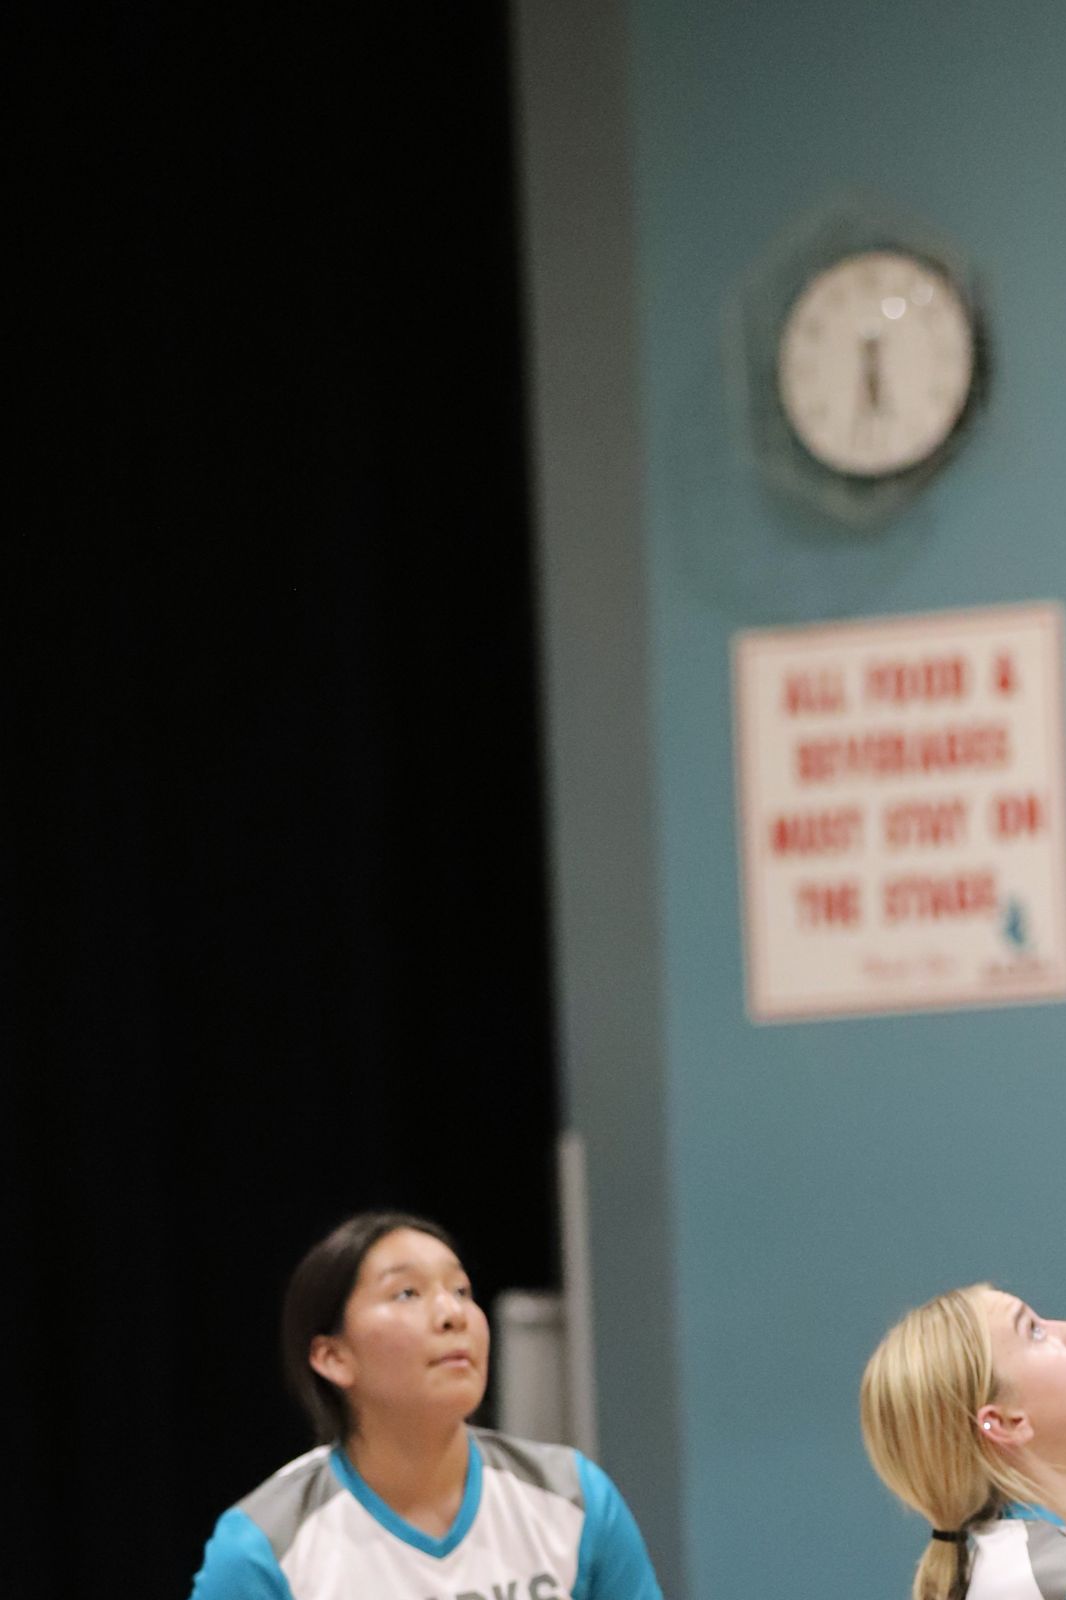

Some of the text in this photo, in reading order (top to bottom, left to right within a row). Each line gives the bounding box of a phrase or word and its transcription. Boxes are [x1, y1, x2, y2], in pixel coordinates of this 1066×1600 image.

[783, 669, 846, 717] ALL
[866, 655, 967, 705] FOOD
[797, 724, 1009, 784] BEVERAGES
[772, 790, 1041, 859] MUST STAY ON
[797, 868, 997, 930] THE STAGE
